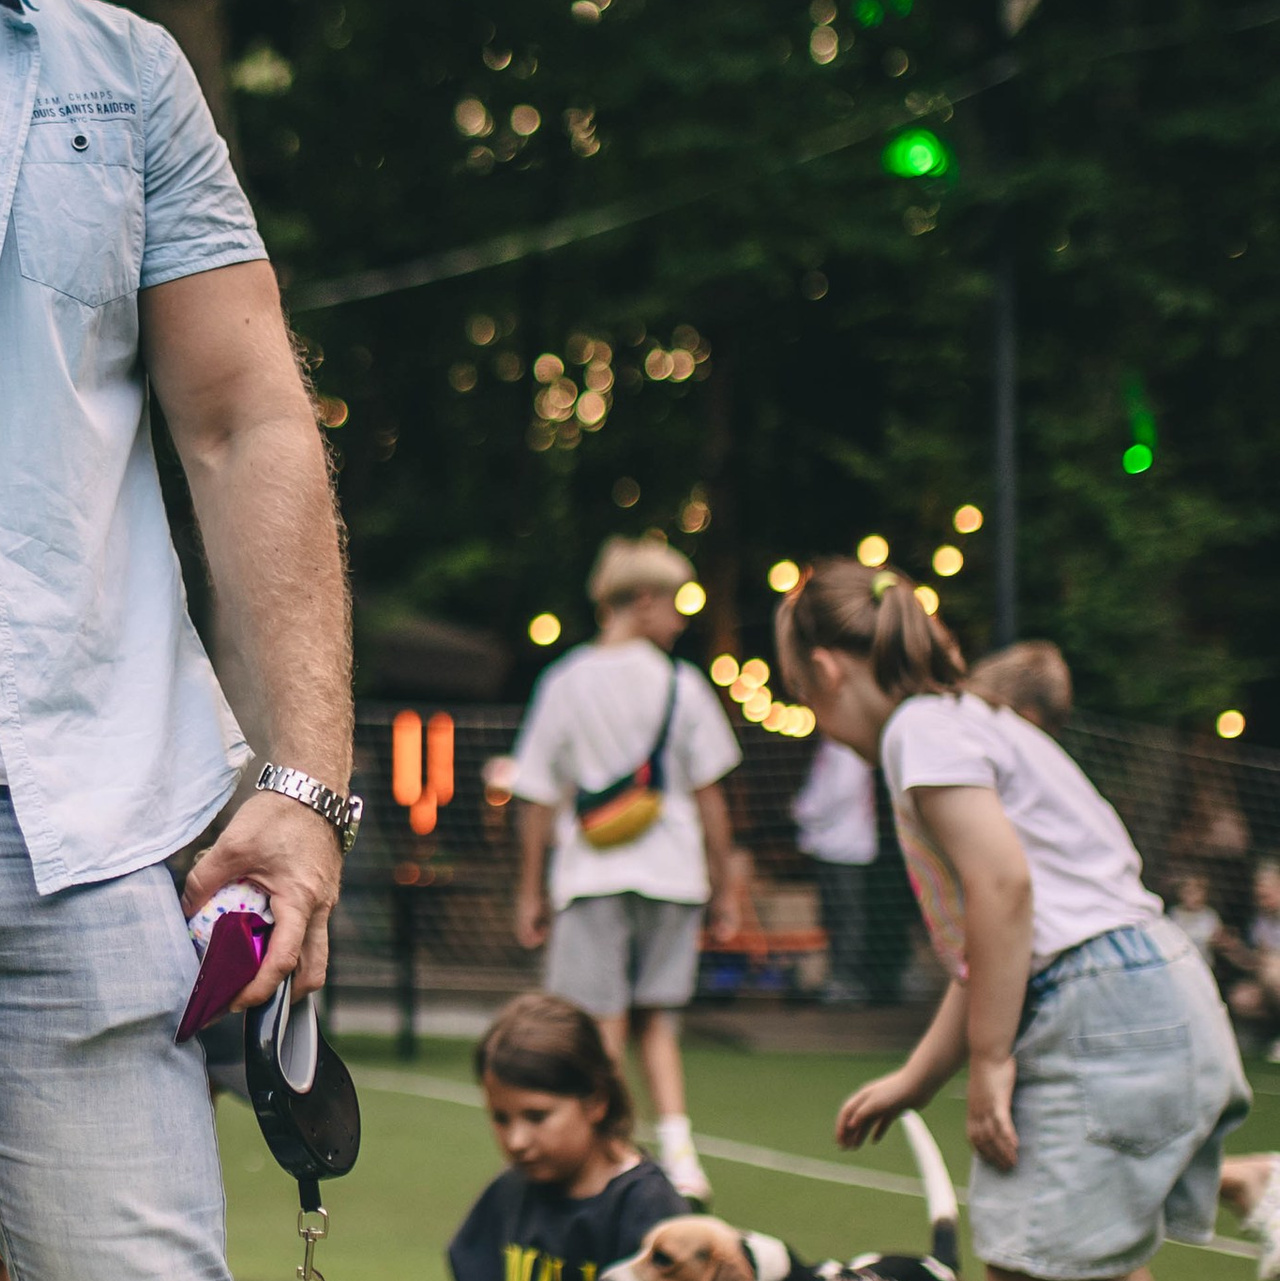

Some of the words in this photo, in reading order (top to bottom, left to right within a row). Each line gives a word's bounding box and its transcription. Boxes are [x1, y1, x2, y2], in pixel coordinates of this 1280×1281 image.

[68, 90, 113, 101] CHAMPS
[59, 103, 94, 117] SAINTS
[96, 102, 136, 115] RAIDERS
[70, 116, 88, 124] NYC
